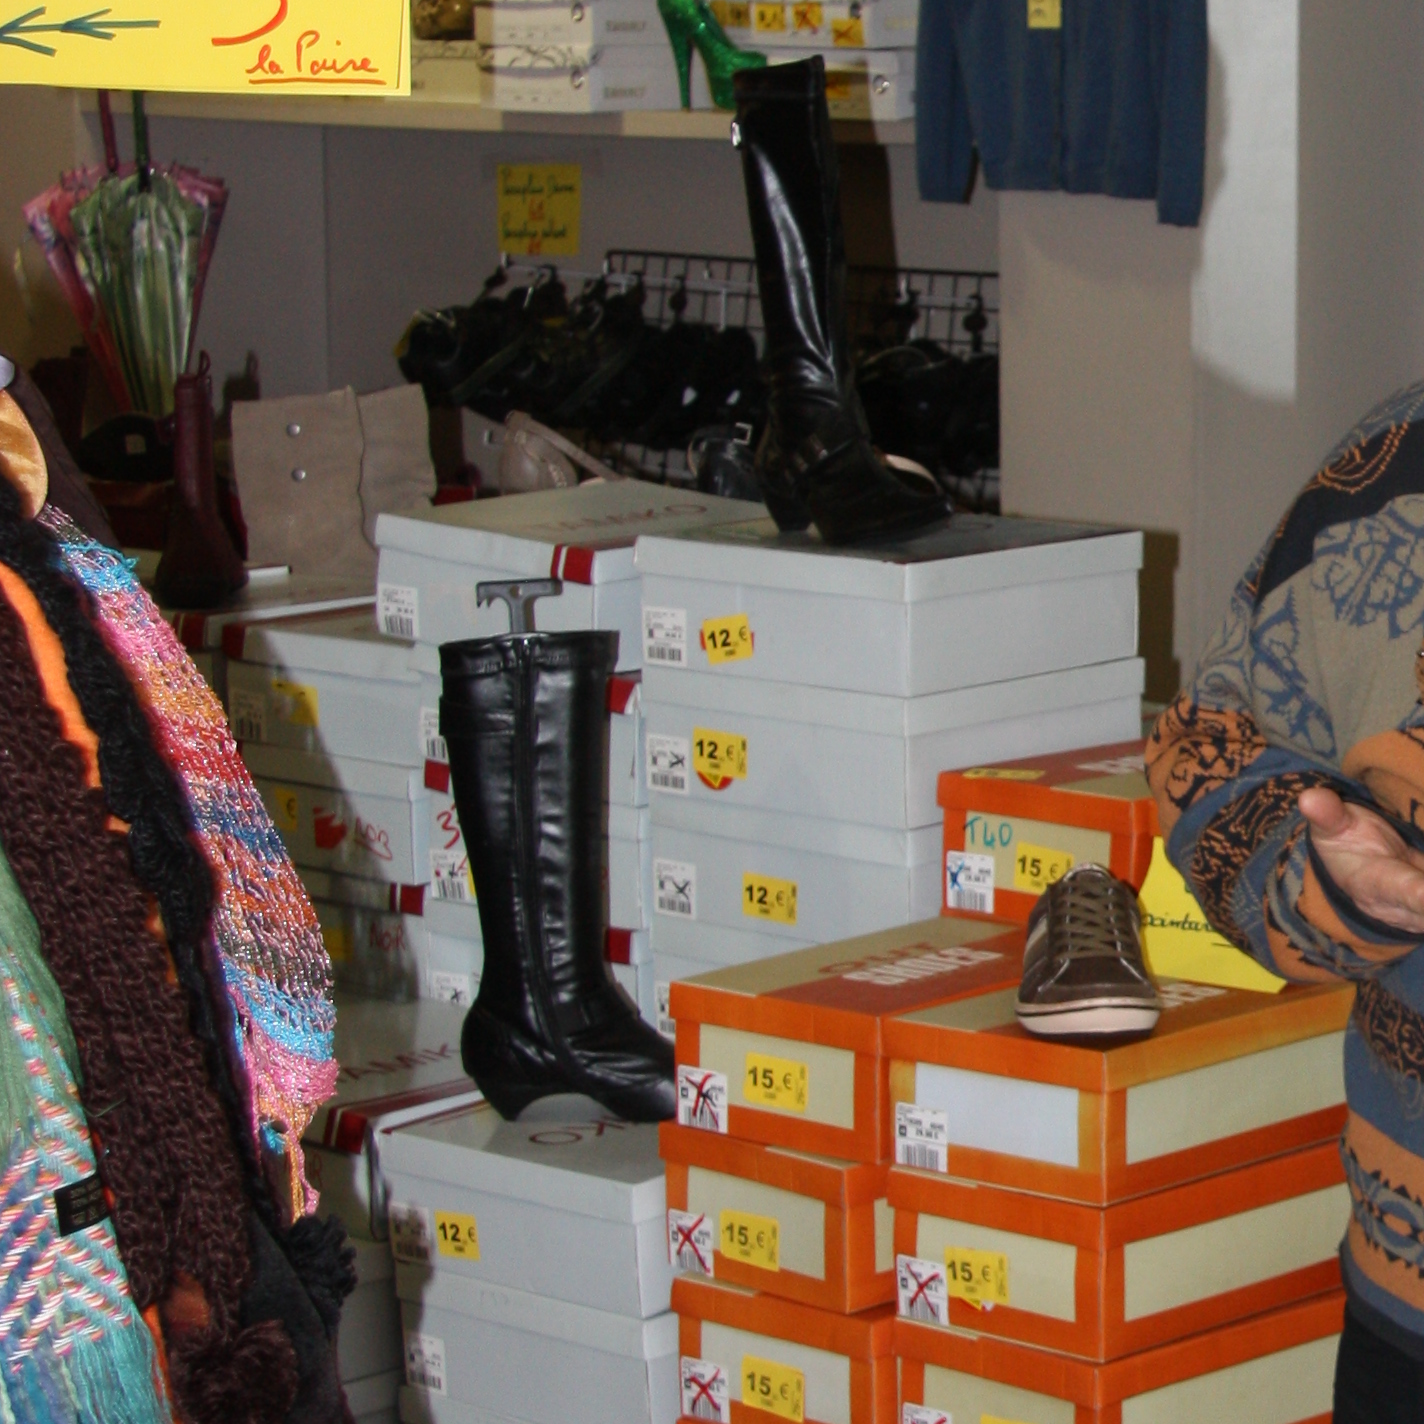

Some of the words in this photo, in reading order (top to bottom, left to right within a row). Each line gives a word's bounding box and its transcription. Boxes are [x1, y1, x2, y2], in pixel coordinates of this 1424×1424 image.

[245, 44, 283, 74] la
[296, 30, 379, 74] Paire
[964, 816, 1013, 850] T40
